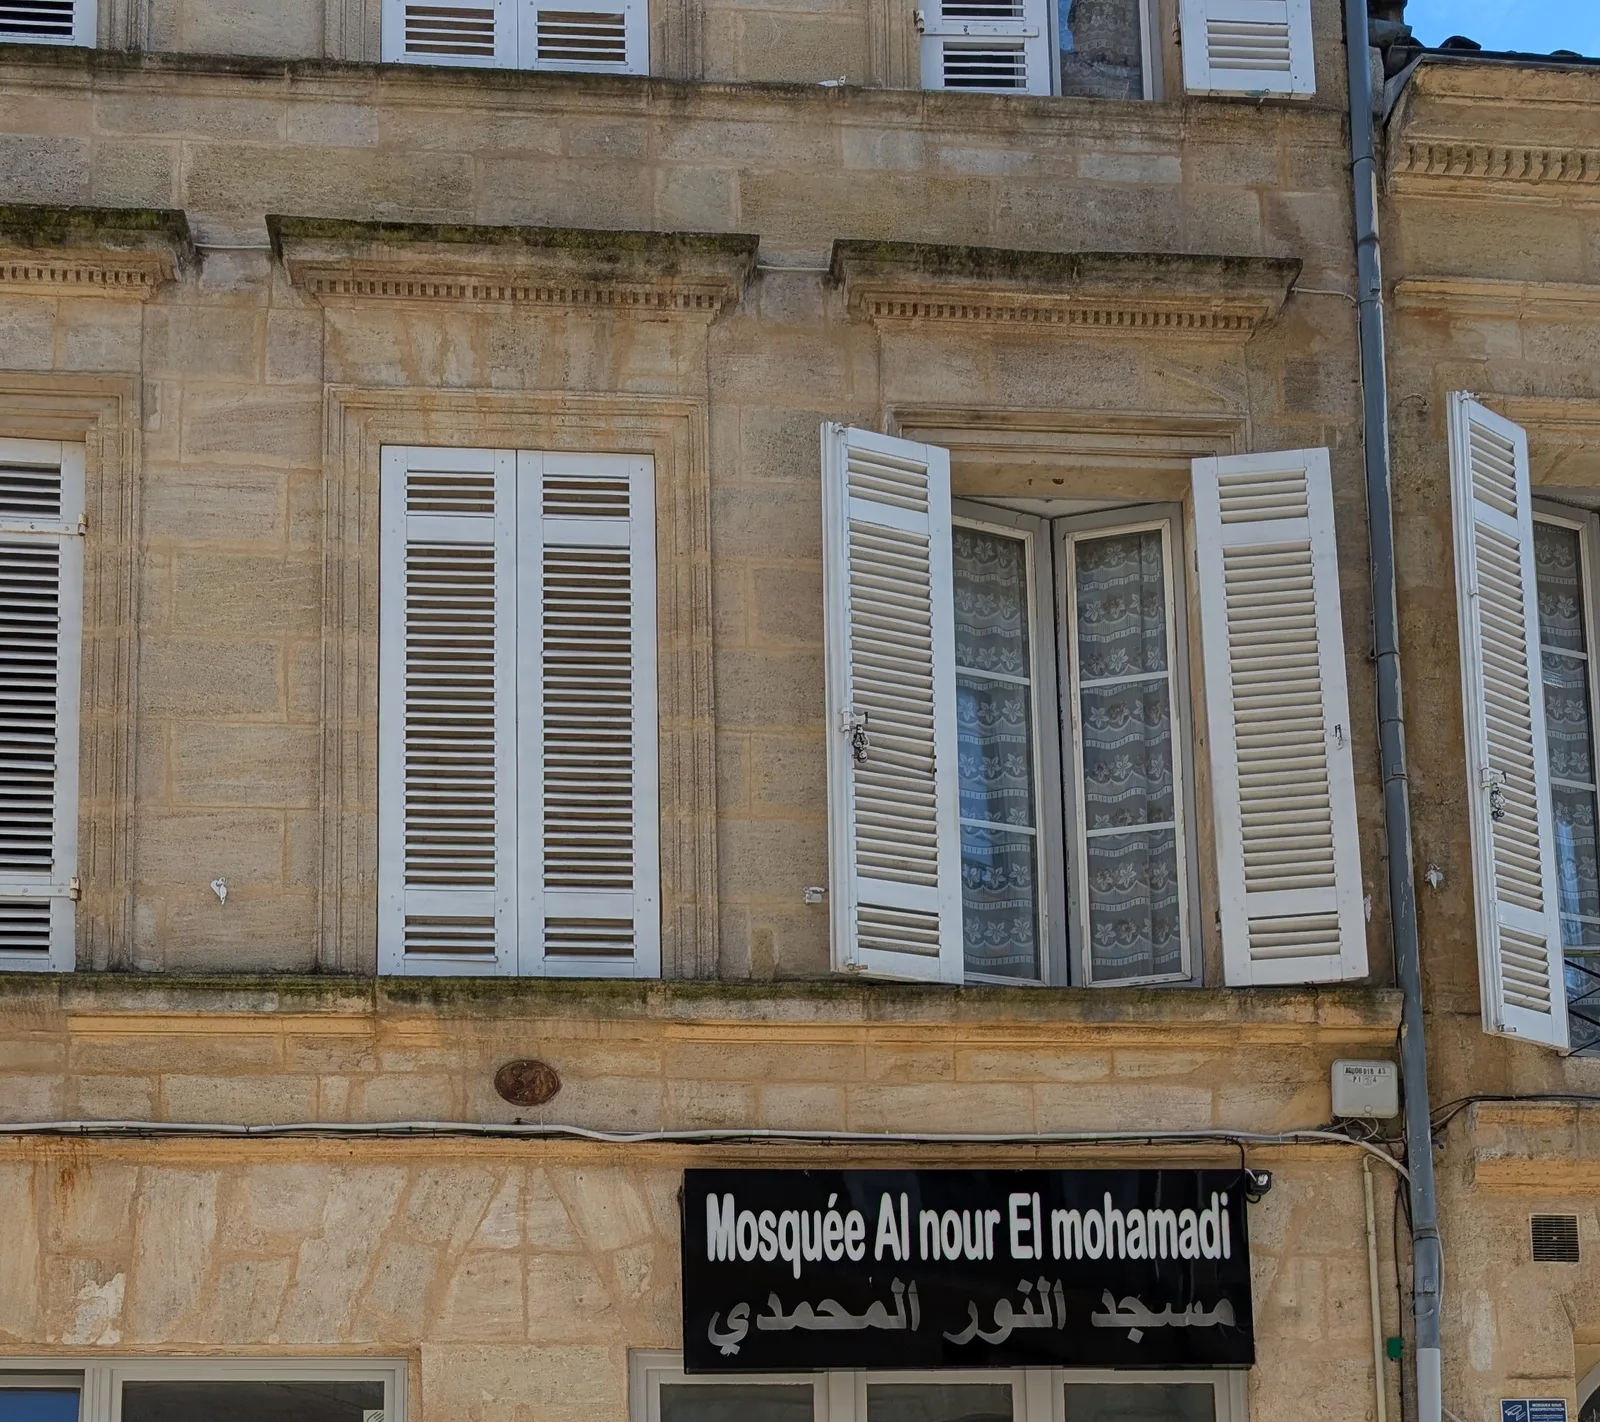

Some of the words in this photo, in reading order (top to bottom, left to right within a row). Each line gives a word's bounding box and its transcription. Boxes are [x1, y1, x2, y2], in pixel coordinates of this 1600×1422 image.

[706, 1193, 866, 1280] Mosquée
[874, 1192, 910, 1261] Al
[919, 1209, 1001, 1261] nour
[1008, 1191, 1043, 1260] El
[1051, 1191, 1231, 1261] mohamadi
[707, 1276, 921, 1357] المحمدي
[942, 1275, 1067, 1345] النور
[1091, 1288, 1236, 1344] مسجد
